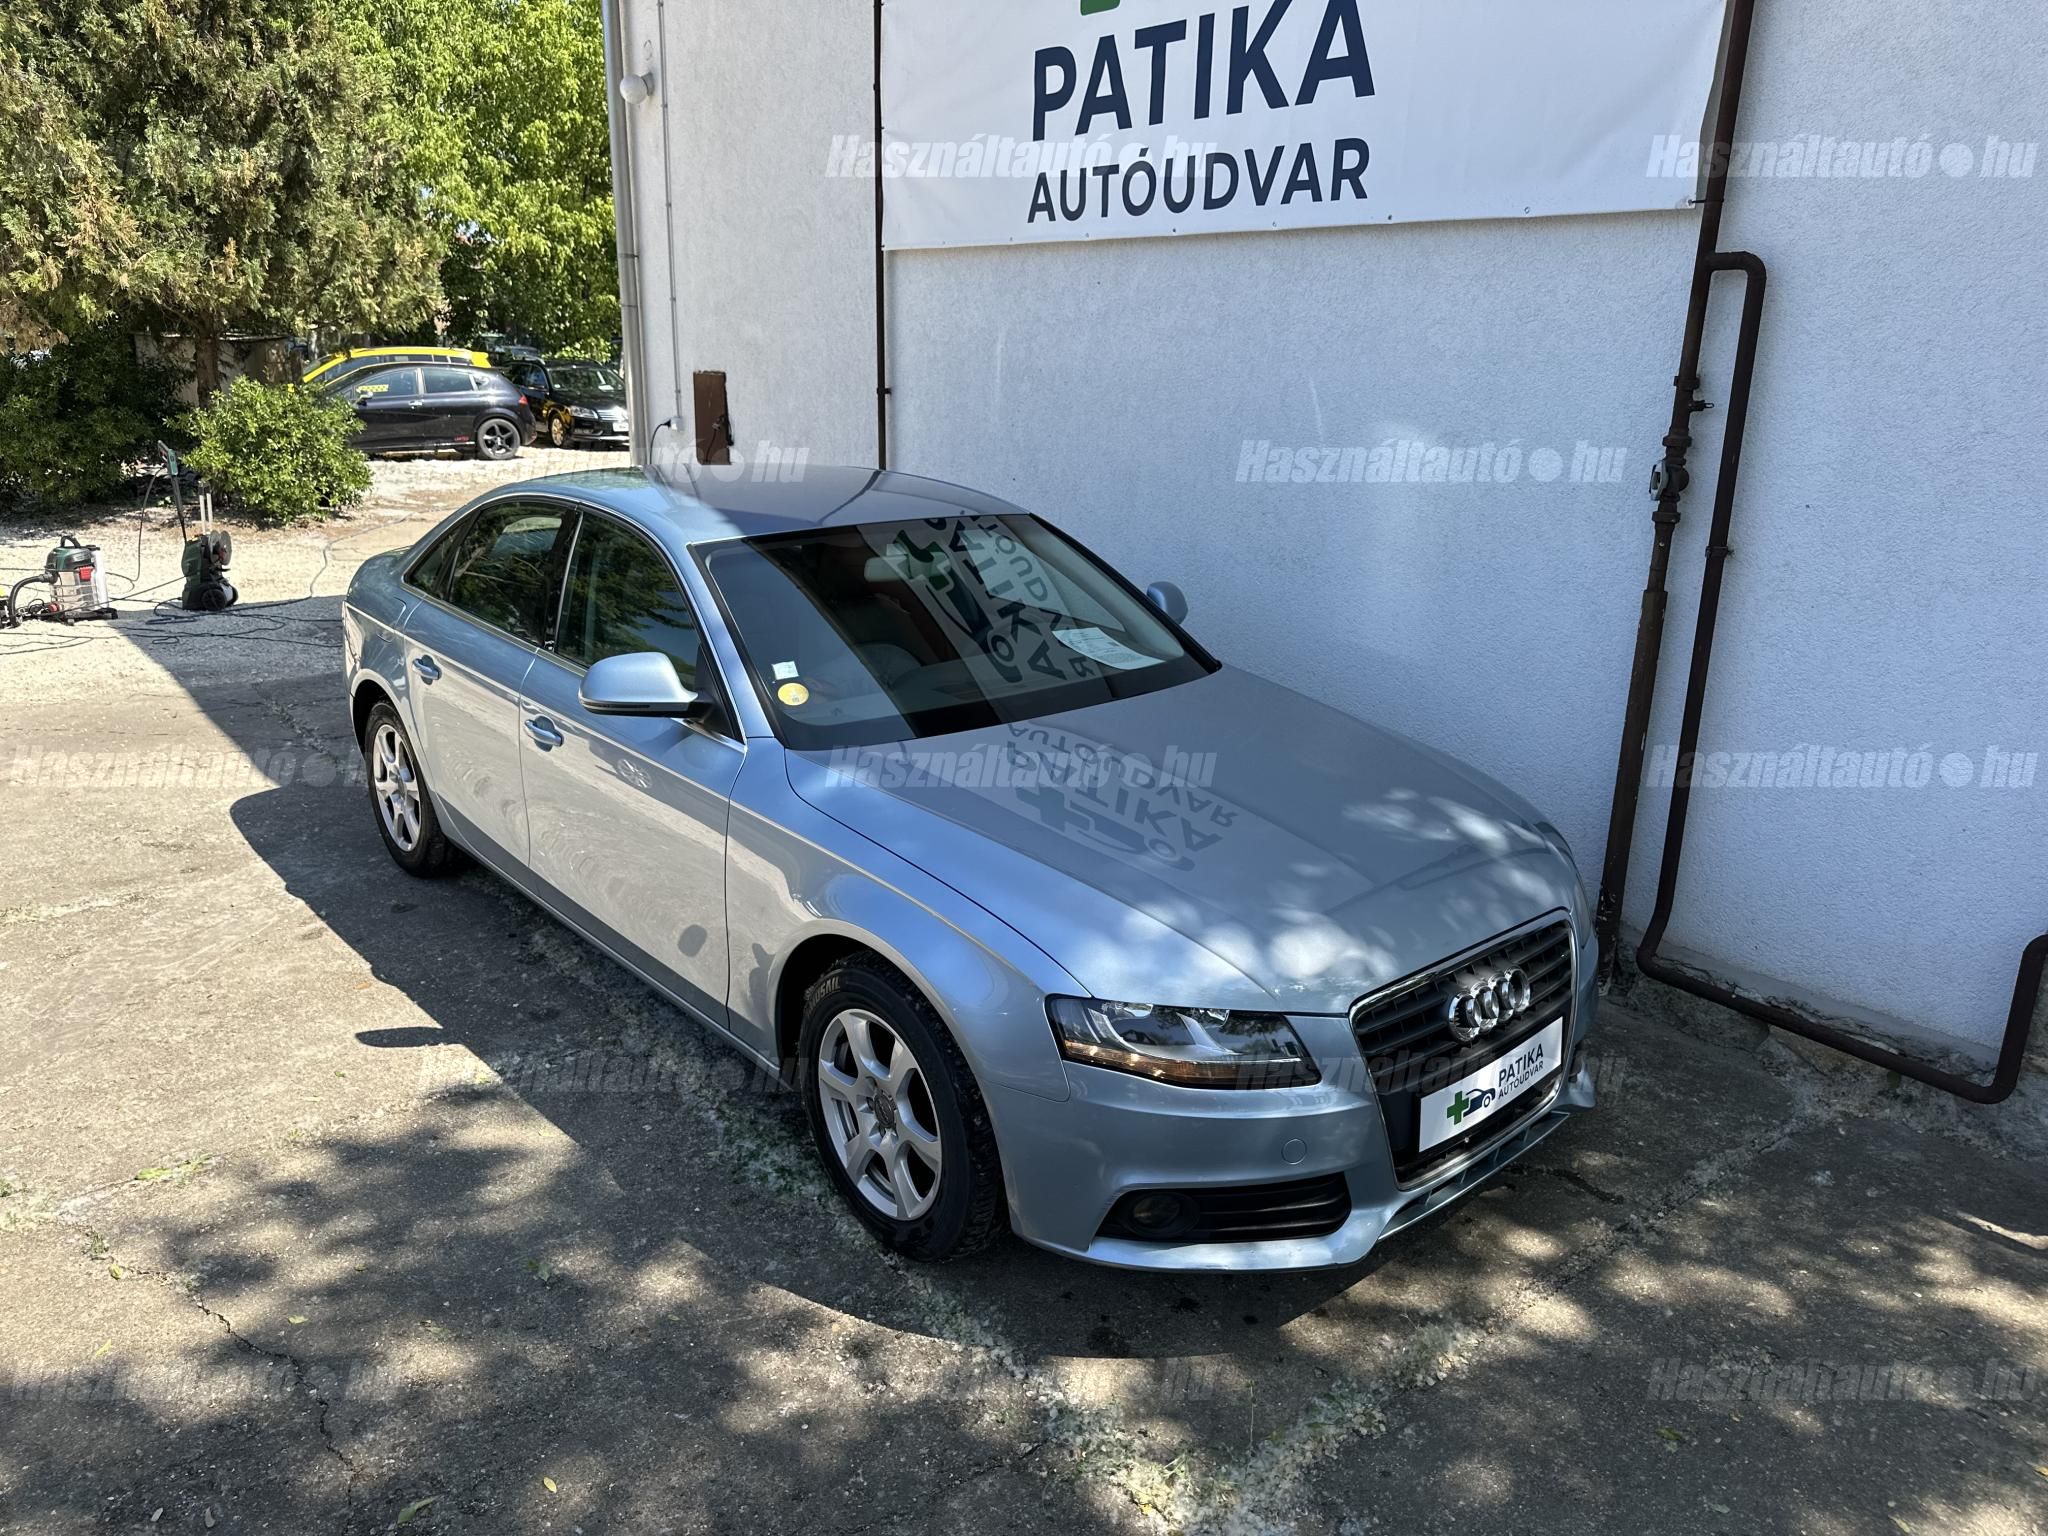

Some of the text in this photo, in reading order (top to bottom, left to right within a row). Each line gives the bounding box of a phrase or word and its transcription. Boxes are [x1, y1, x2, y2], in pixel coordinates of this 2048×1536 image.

[1032, 0, 1375, 141] PATIKA
[1027, 137, 1370, 224] AUTÓUDVAR
[1499, 1043, 1543, 1087] PATIKA
[1499, 1060, 1543, 1099] AUTÓUDVAR
